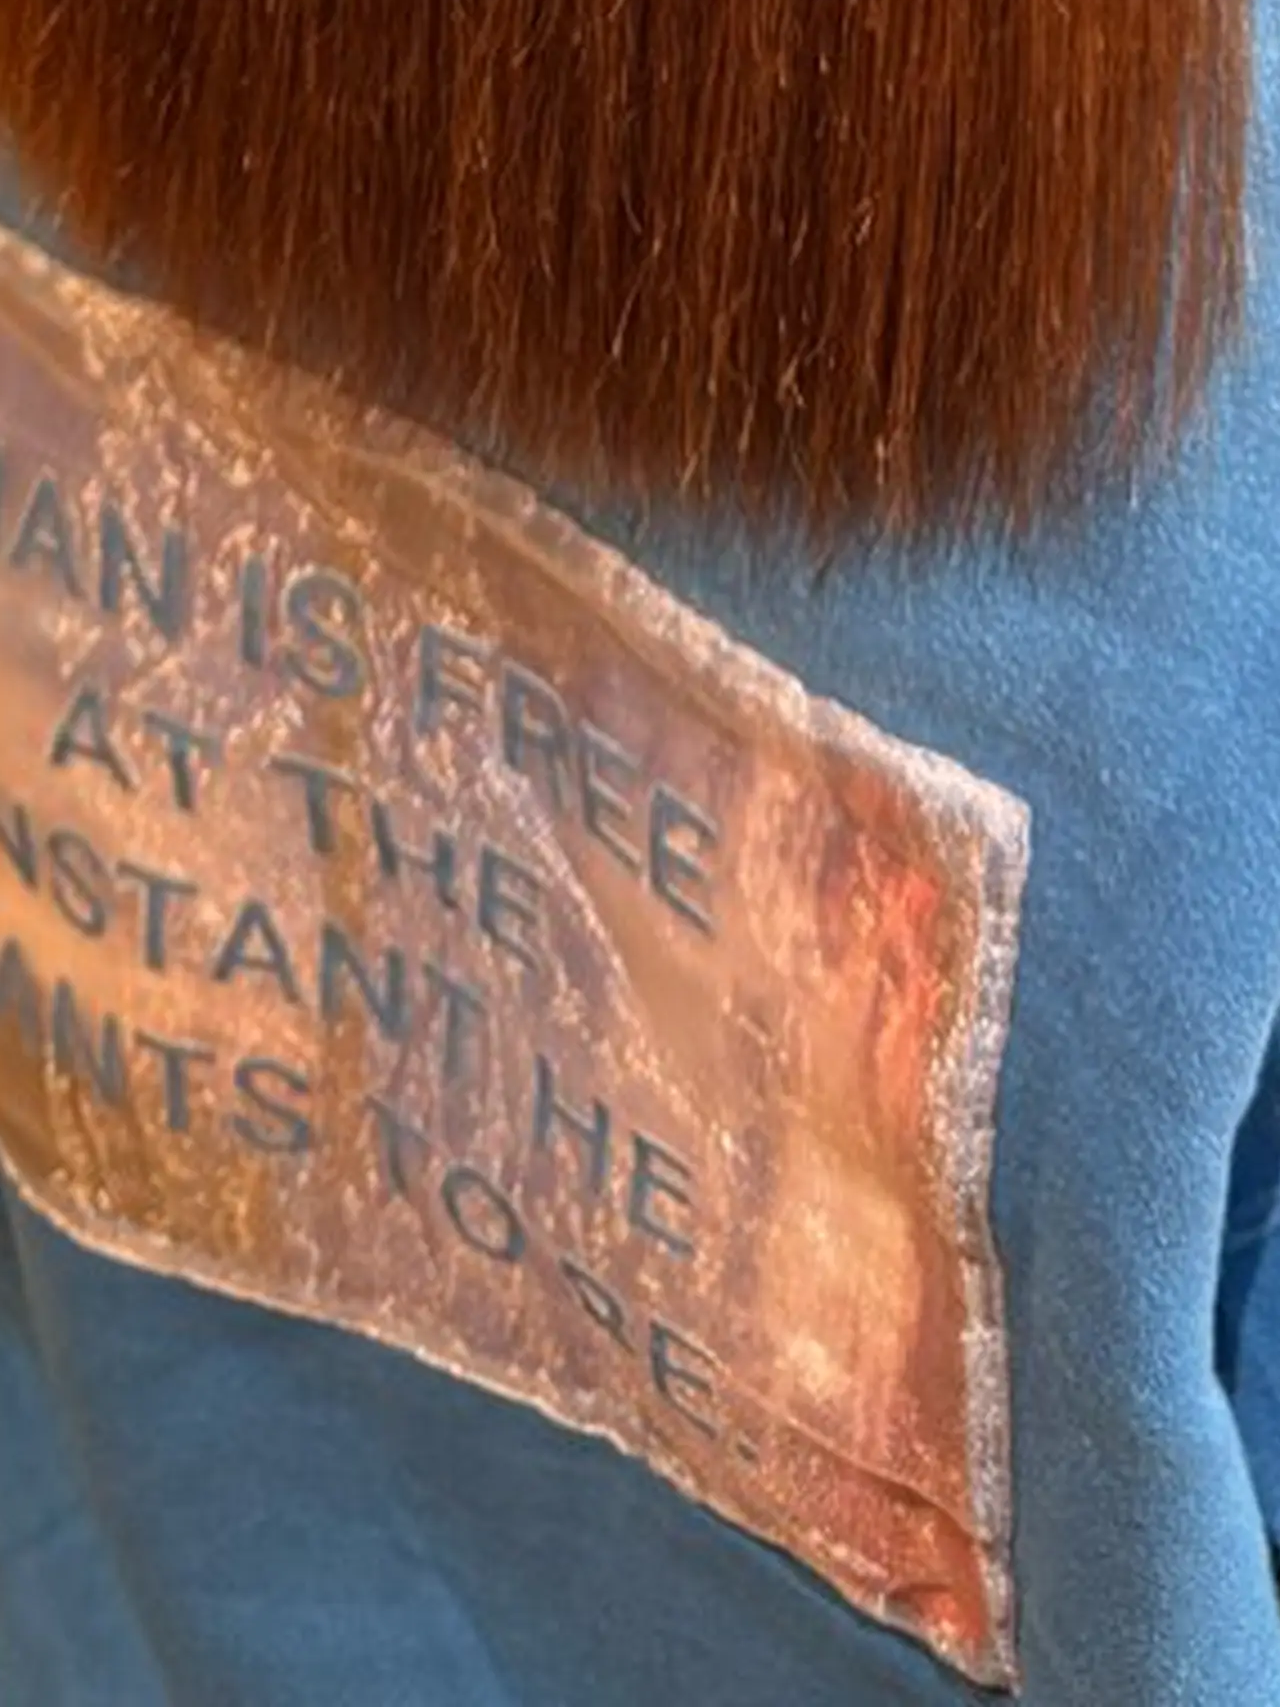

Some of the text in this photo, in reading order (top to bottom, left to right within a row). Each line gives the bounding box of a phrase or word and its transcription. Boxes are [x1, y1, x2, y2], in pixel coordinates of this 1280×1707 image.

[48, 681, 544, 973] AT THE
[239, 549, 370, 700] IS
[415, 620, 719, 937] FREE
[366, 1095, 526, 1265] TO
[531, 1053, 697, 1261] HE
